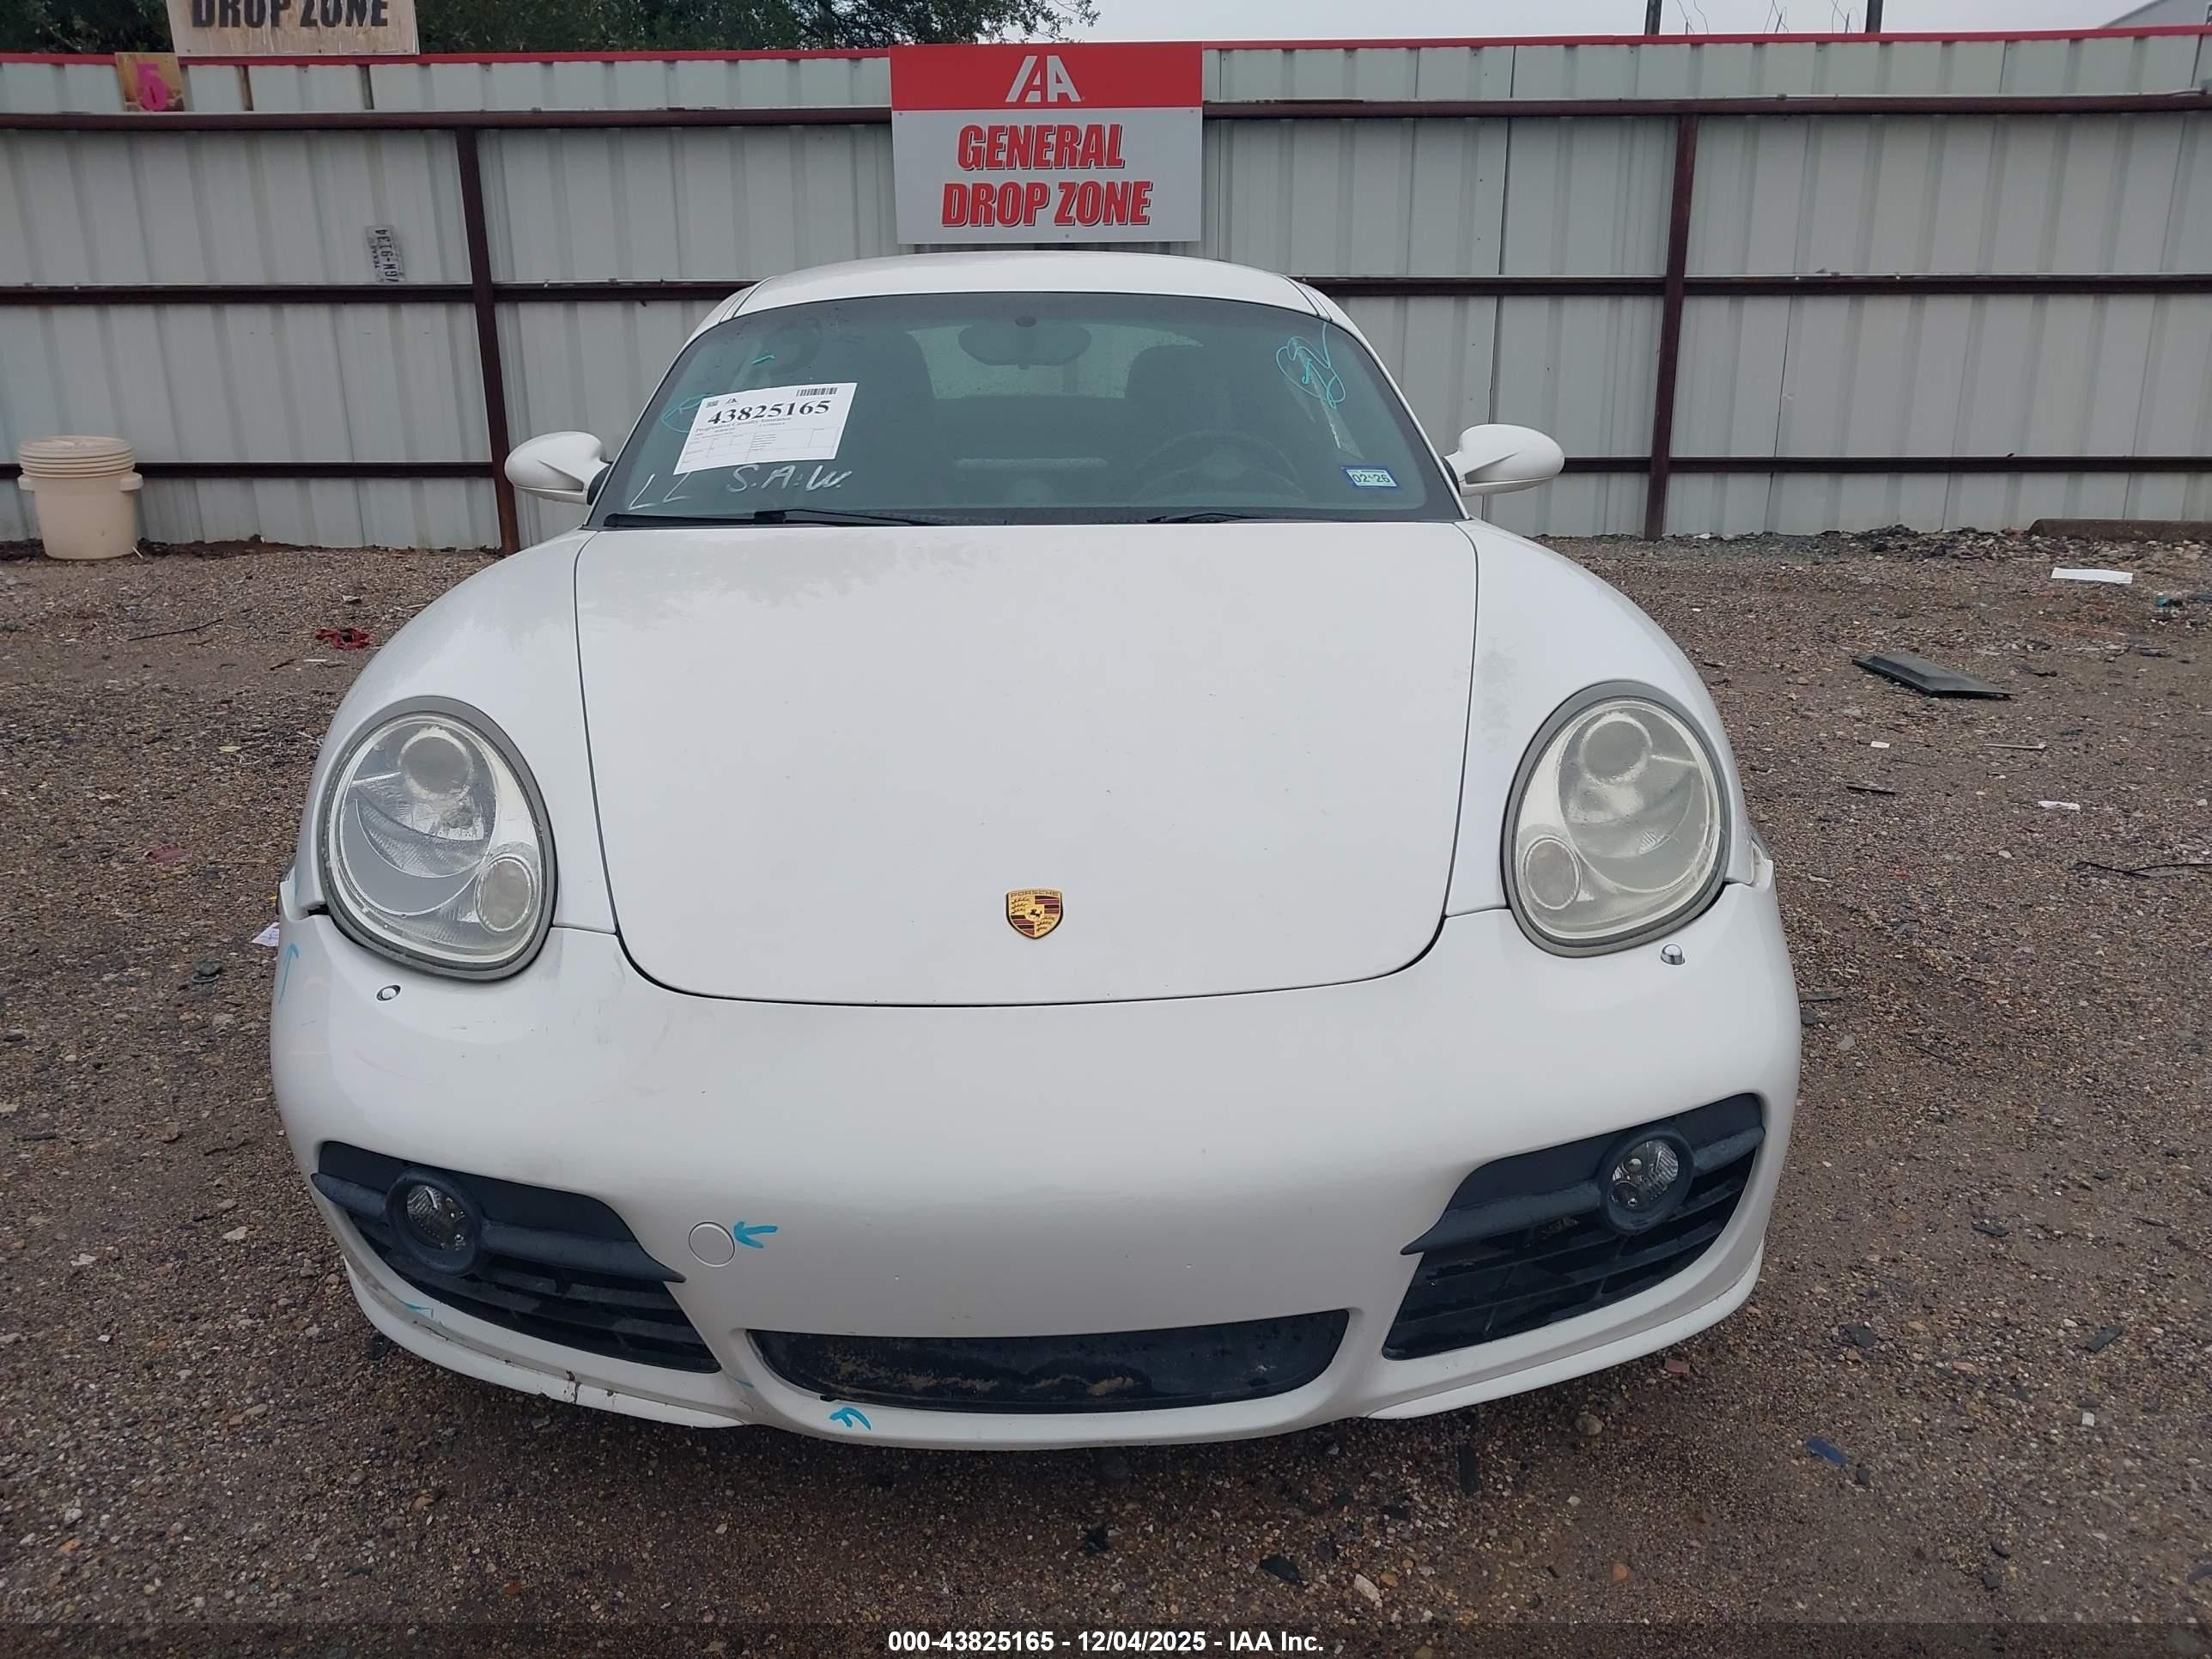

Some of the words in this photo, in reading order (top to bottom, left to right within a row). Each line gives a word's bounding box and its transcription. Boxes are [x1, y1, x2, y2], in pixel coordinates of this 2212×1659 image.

[191, 0, 292, 28] DROP
[300, 0, 389, 27] ZONE
[957, 123, 1126, 171] GENERAL
[941, 181, 1049, 228] DROP
[1053, 180, 1154, 227] ZONE
[370, 245, 380, 269] TEXAS
[707, 399, 832, 425] 43825165
